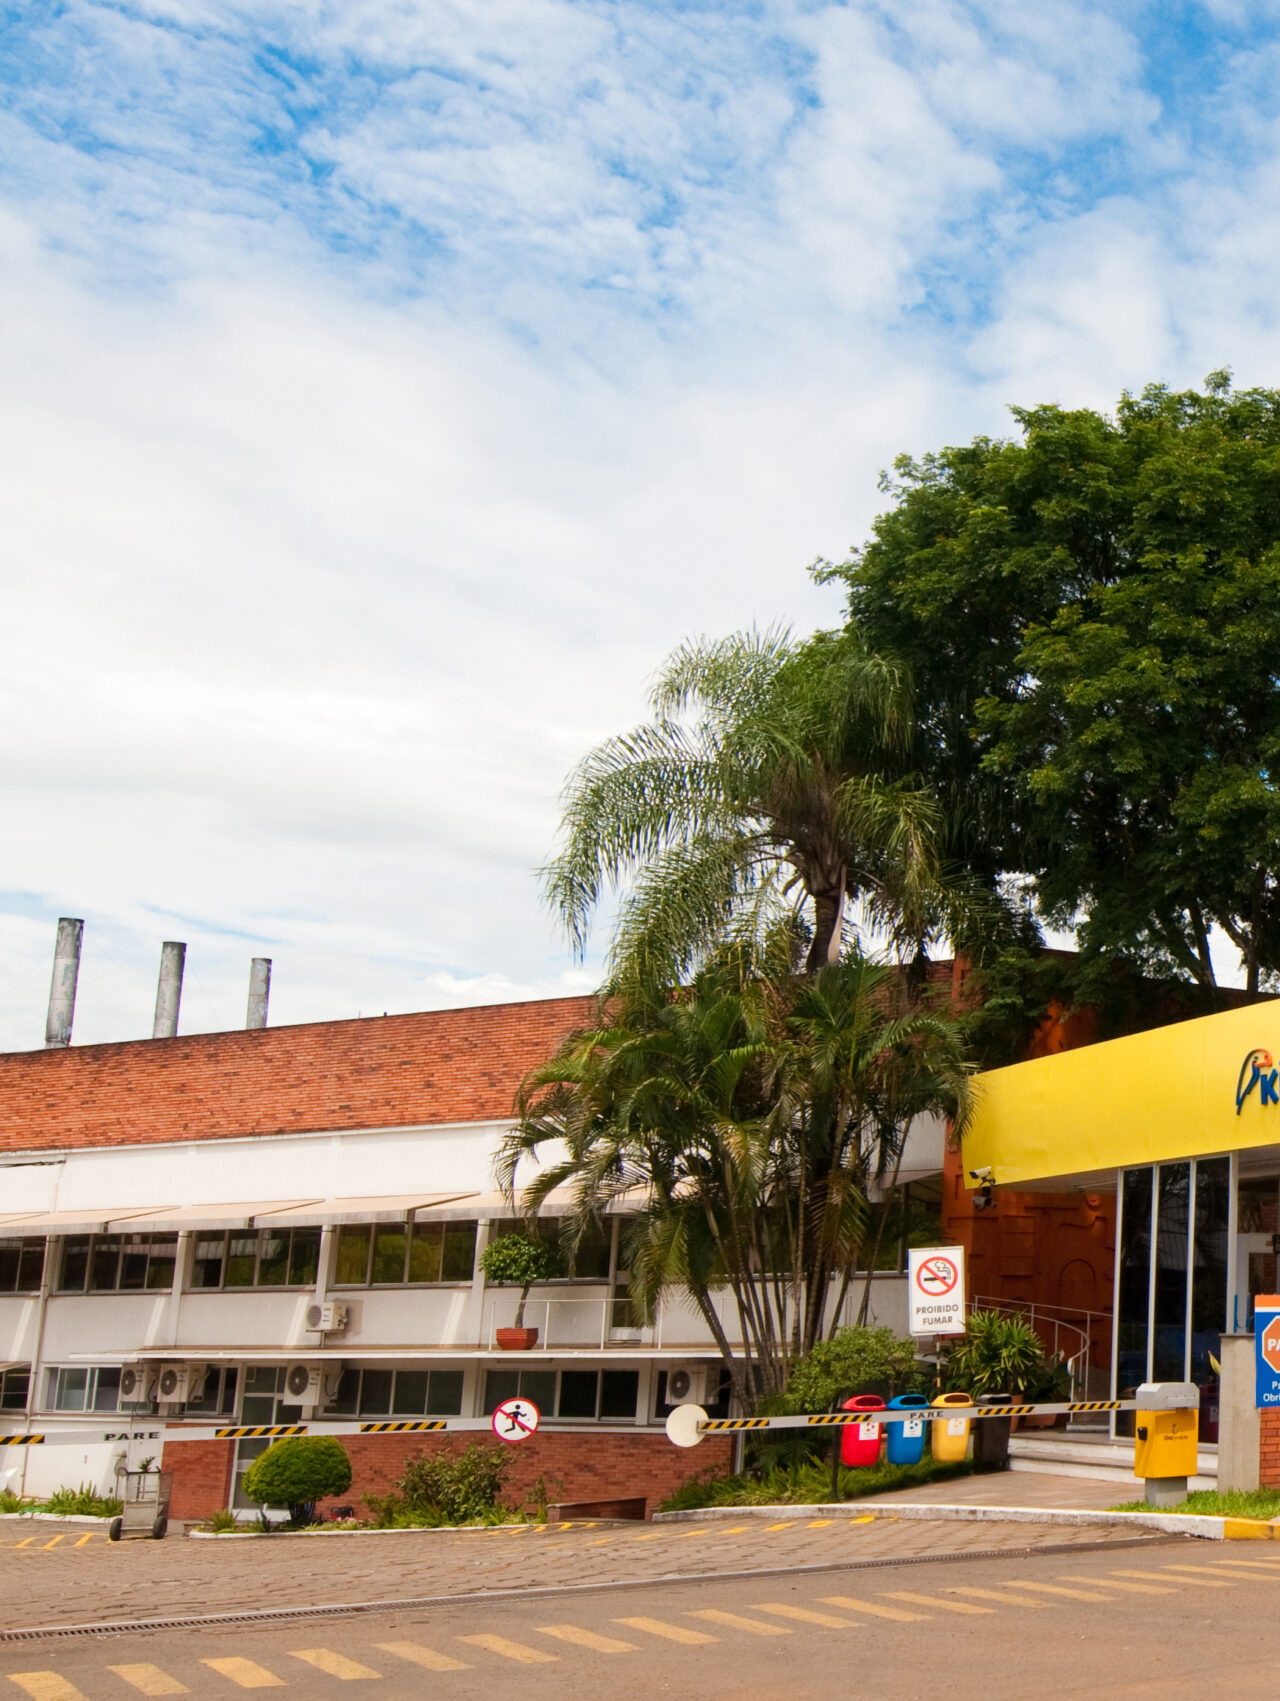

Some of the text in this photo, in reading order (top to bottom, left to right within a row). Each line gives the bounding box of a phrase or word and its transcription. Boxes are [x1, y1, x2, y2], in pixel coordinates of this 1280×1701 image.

[916, 1304, 959, 1314] PROIBIDO
[923, 1316, 953, 1325] FUMAR
[910, 1410, 944, 1419] PARE
[104, 1431, 160, 1441] PARE
